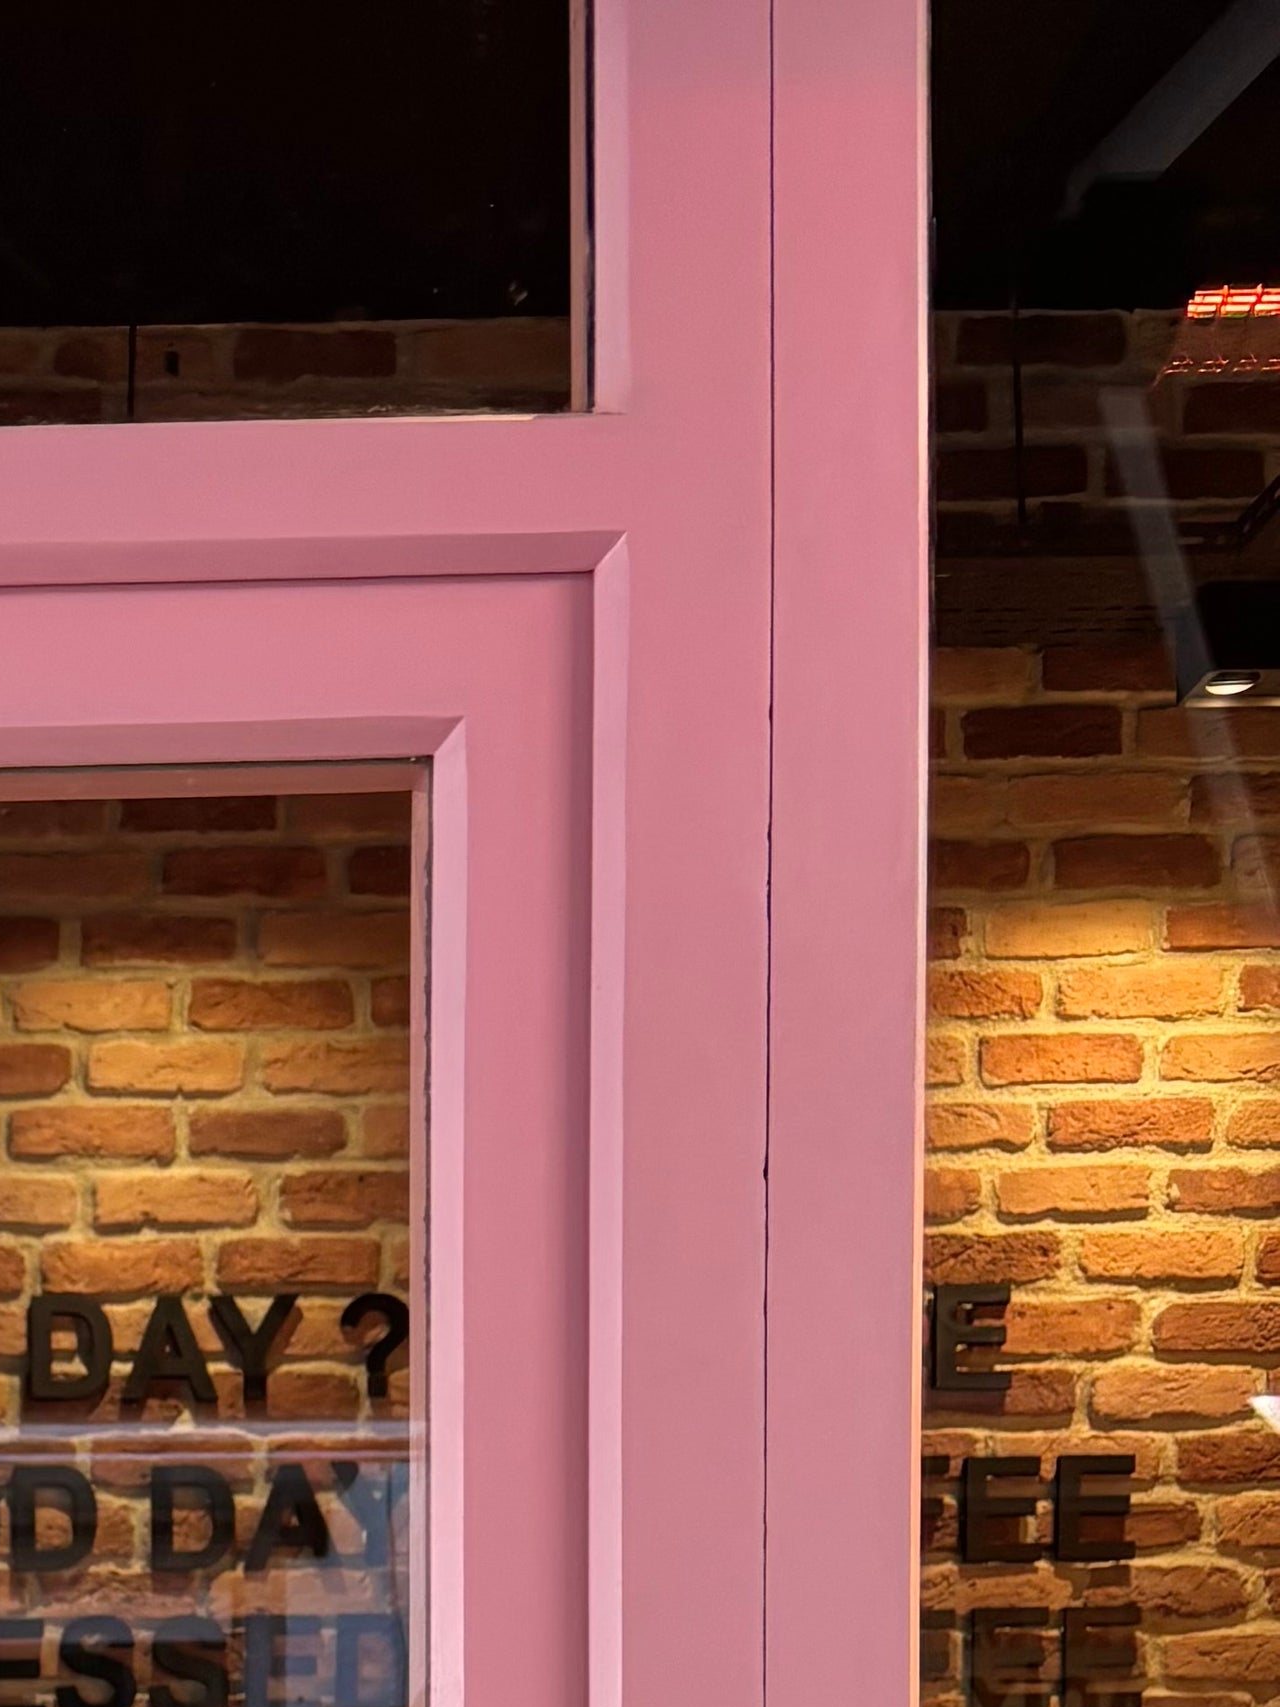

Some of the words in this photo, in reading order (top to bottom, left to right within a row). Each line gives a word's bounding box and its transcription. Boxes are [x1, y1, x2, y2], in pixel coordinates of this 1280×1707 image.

[24, 1293, 300, 1402] DAY
[341, 1292, 409, 1398] ?
[149, 1461, 408, 1572] DAY
